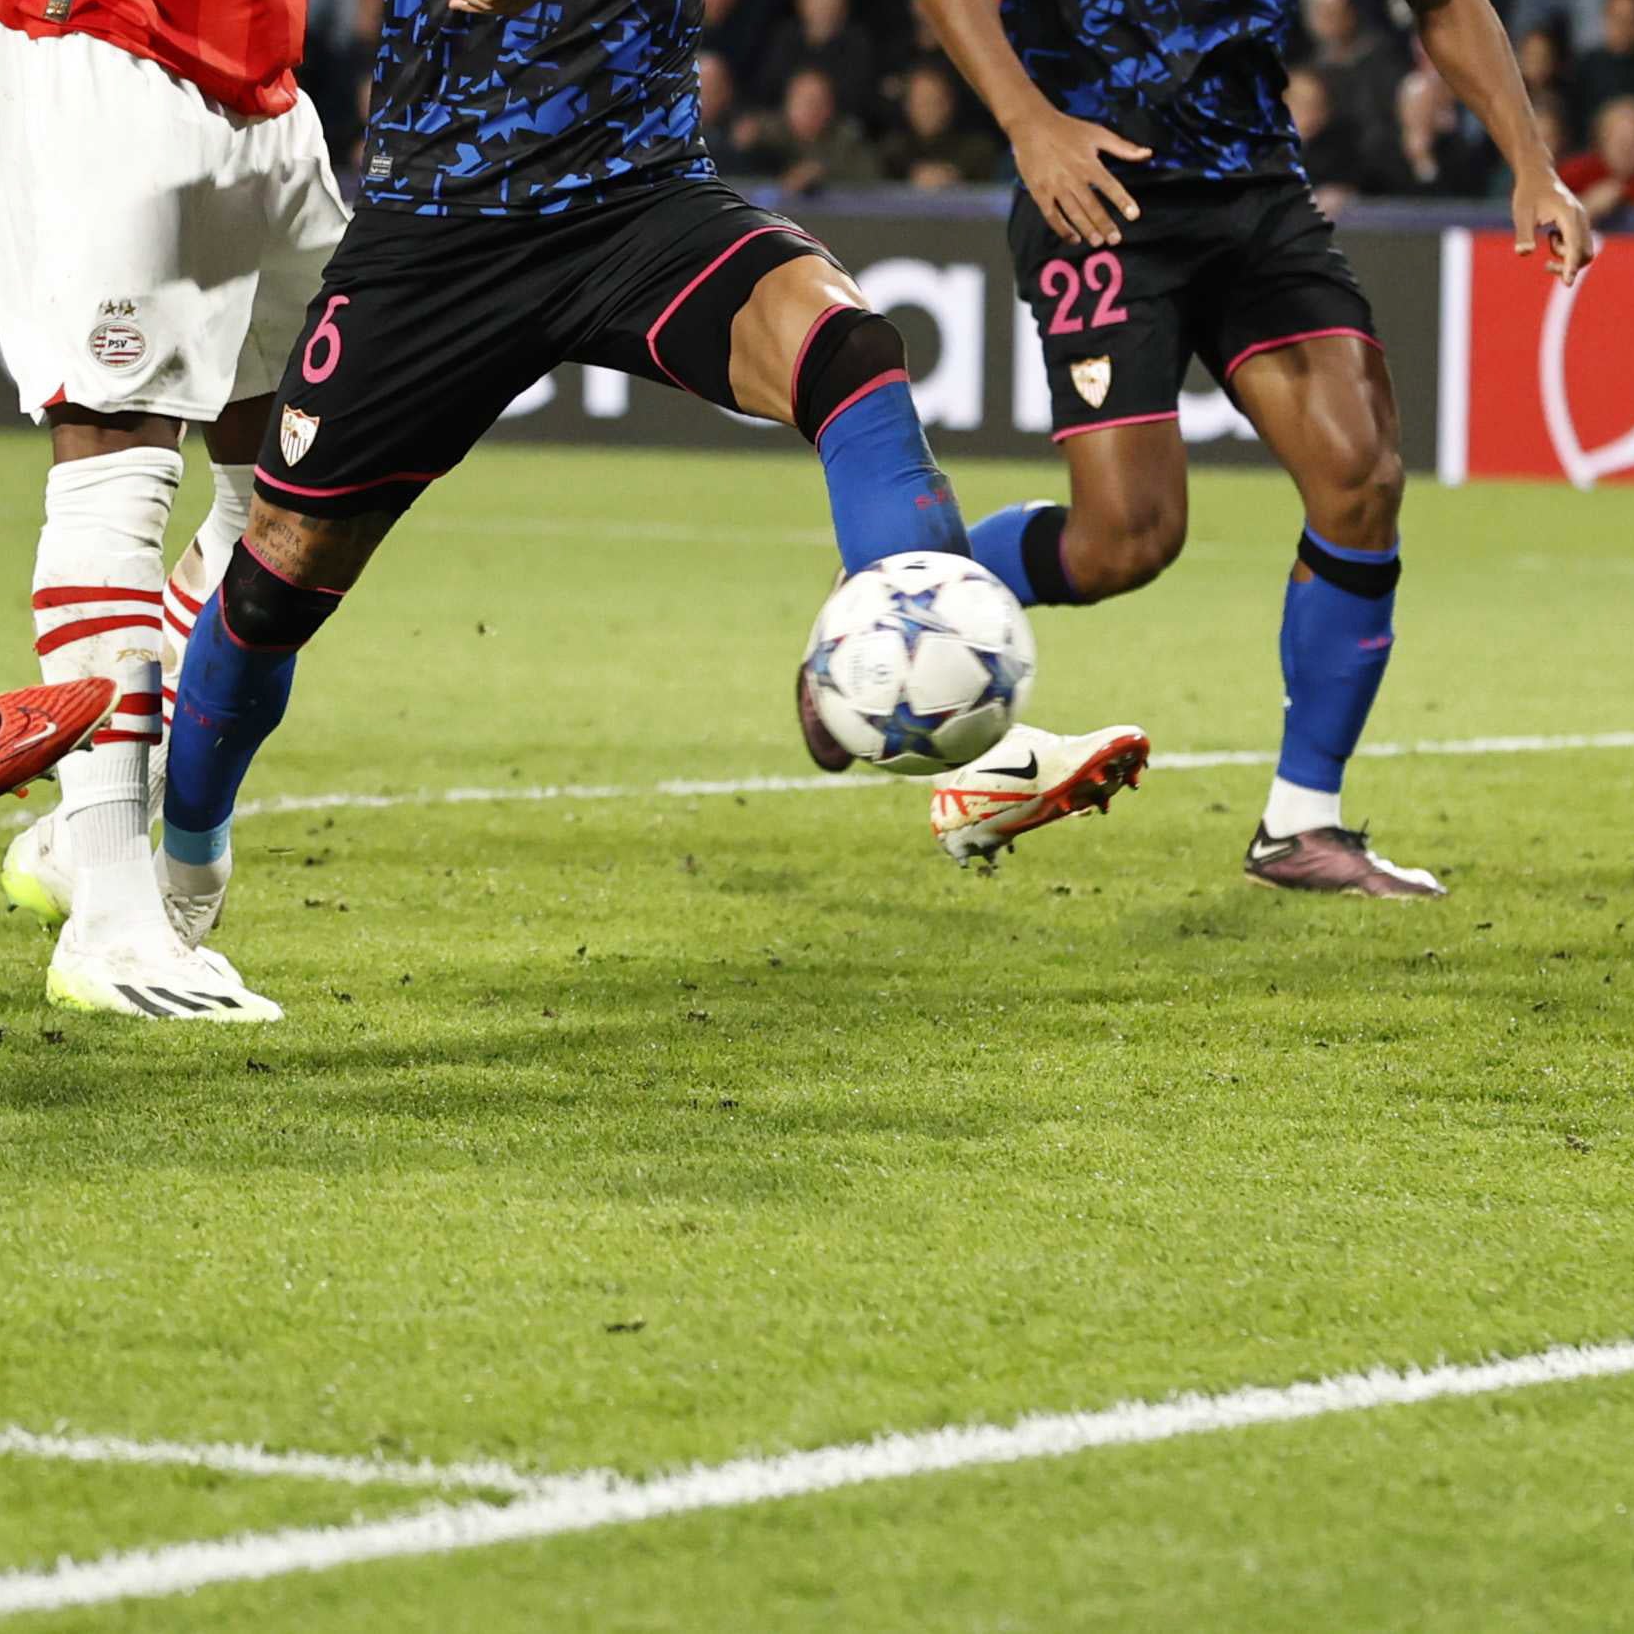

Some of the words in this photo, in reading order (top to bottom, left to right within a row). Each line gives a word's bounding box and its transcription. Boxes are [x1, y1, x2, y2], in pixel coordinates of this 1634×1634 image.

[1040, 251, 1128, 335] 22
[107, 338, 128, 349] PSV
[302, 294, 351, 384] 6
